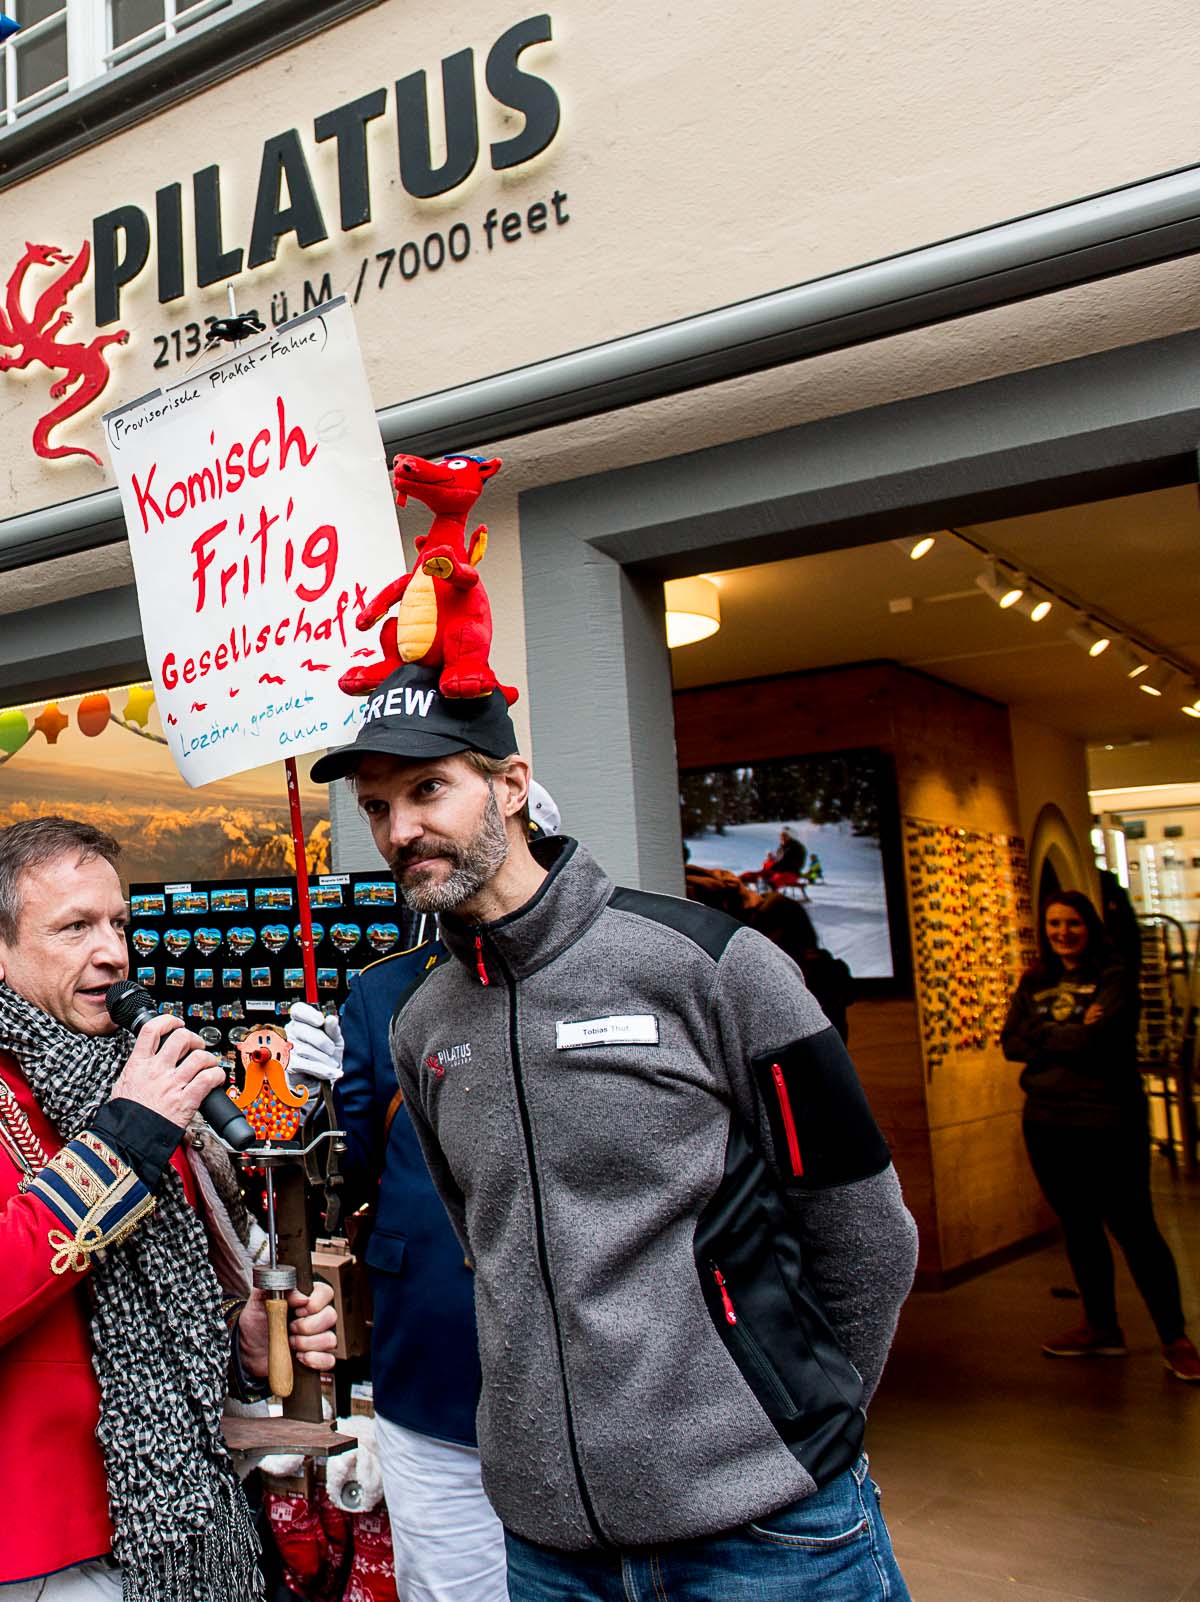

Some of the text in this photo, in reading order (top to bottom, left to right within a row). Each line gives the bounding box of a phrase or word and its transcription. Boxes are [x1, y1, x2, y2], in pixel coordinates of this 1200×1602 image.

[92, 13, 561, 328] PILATUS
[482, 190, 570, 250] feet
[132, 396, 318, 534] Komisch
[191, 496, 339, 613] Fritig
[161, 582, 368, 691] Gesellschaft
[279, 720, 329, 745] anno
[437, 1042, 472, 1065] PILATUS
